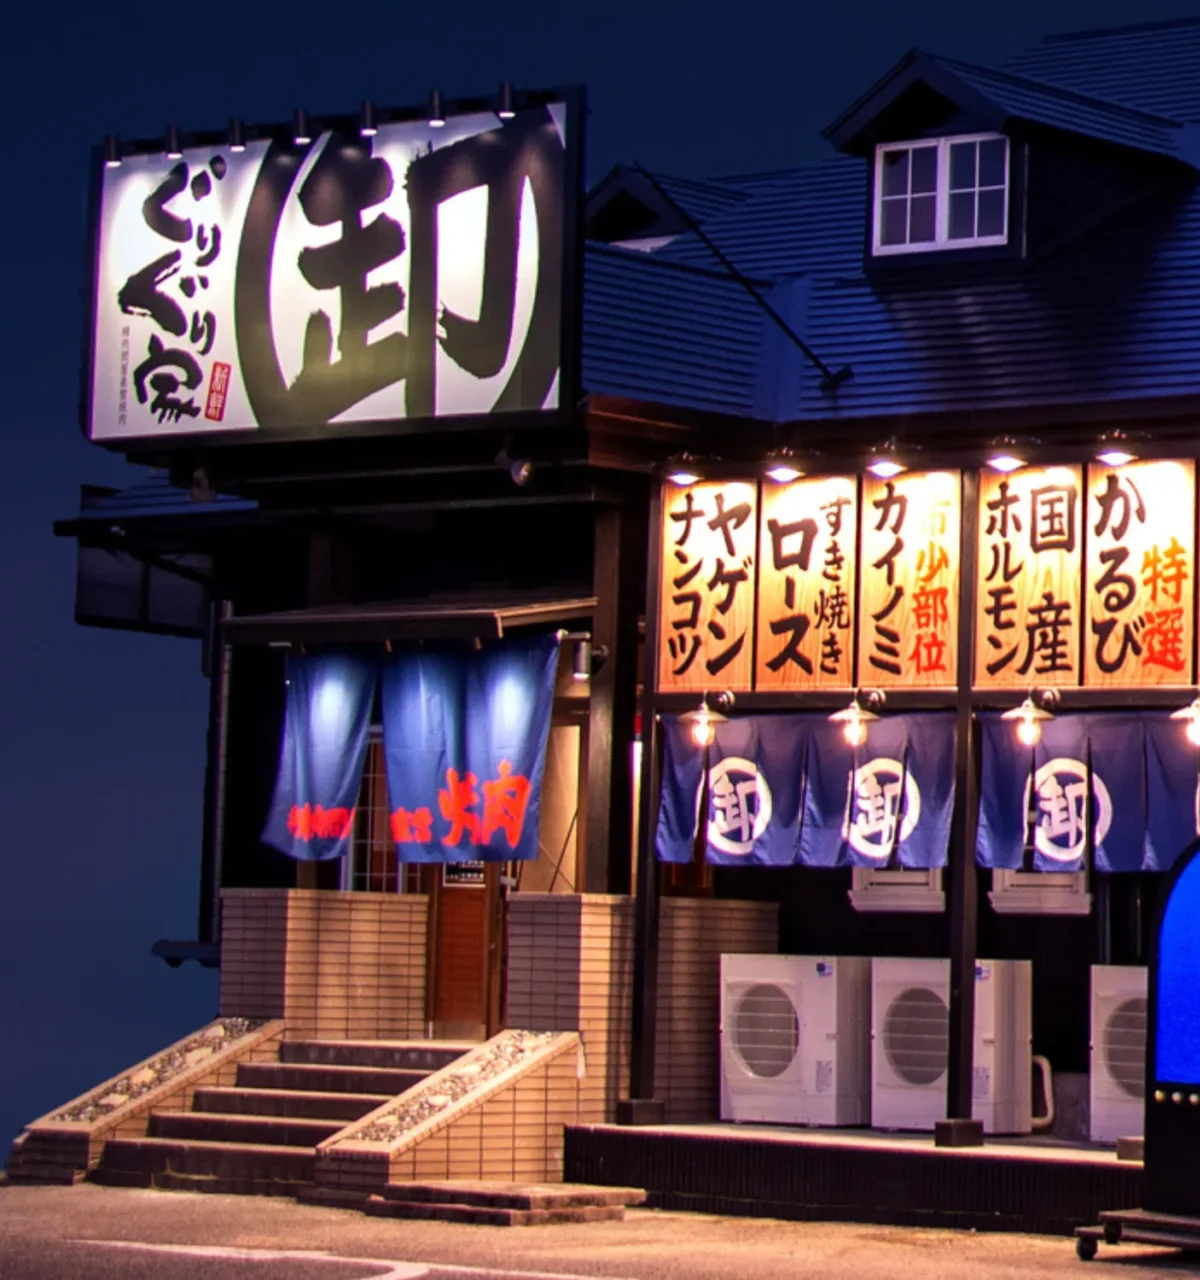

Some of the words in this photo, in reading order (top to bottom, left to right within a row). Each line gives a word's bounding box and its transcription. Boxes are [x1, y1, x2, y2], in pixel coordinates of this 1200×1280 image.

[118, 154, 227, 424] ぐりぐり家
[296, 125, 520, 422] 卸
[668, 493, 705, 676] ナンコツ
[706, 493, 753, 676] ヤゲン
[765, 518, 818, 675] ロース
[814, 497, 853, 675] すき焼き
[869, 483, 908, 676] カイノミ
[985, 481, 1024, 676] ホルモン
[1016, 485, 1078, 676] 国産
[1092, 474, 1146, 673] かるび
[1140, 536, 1189, 672] 特選
